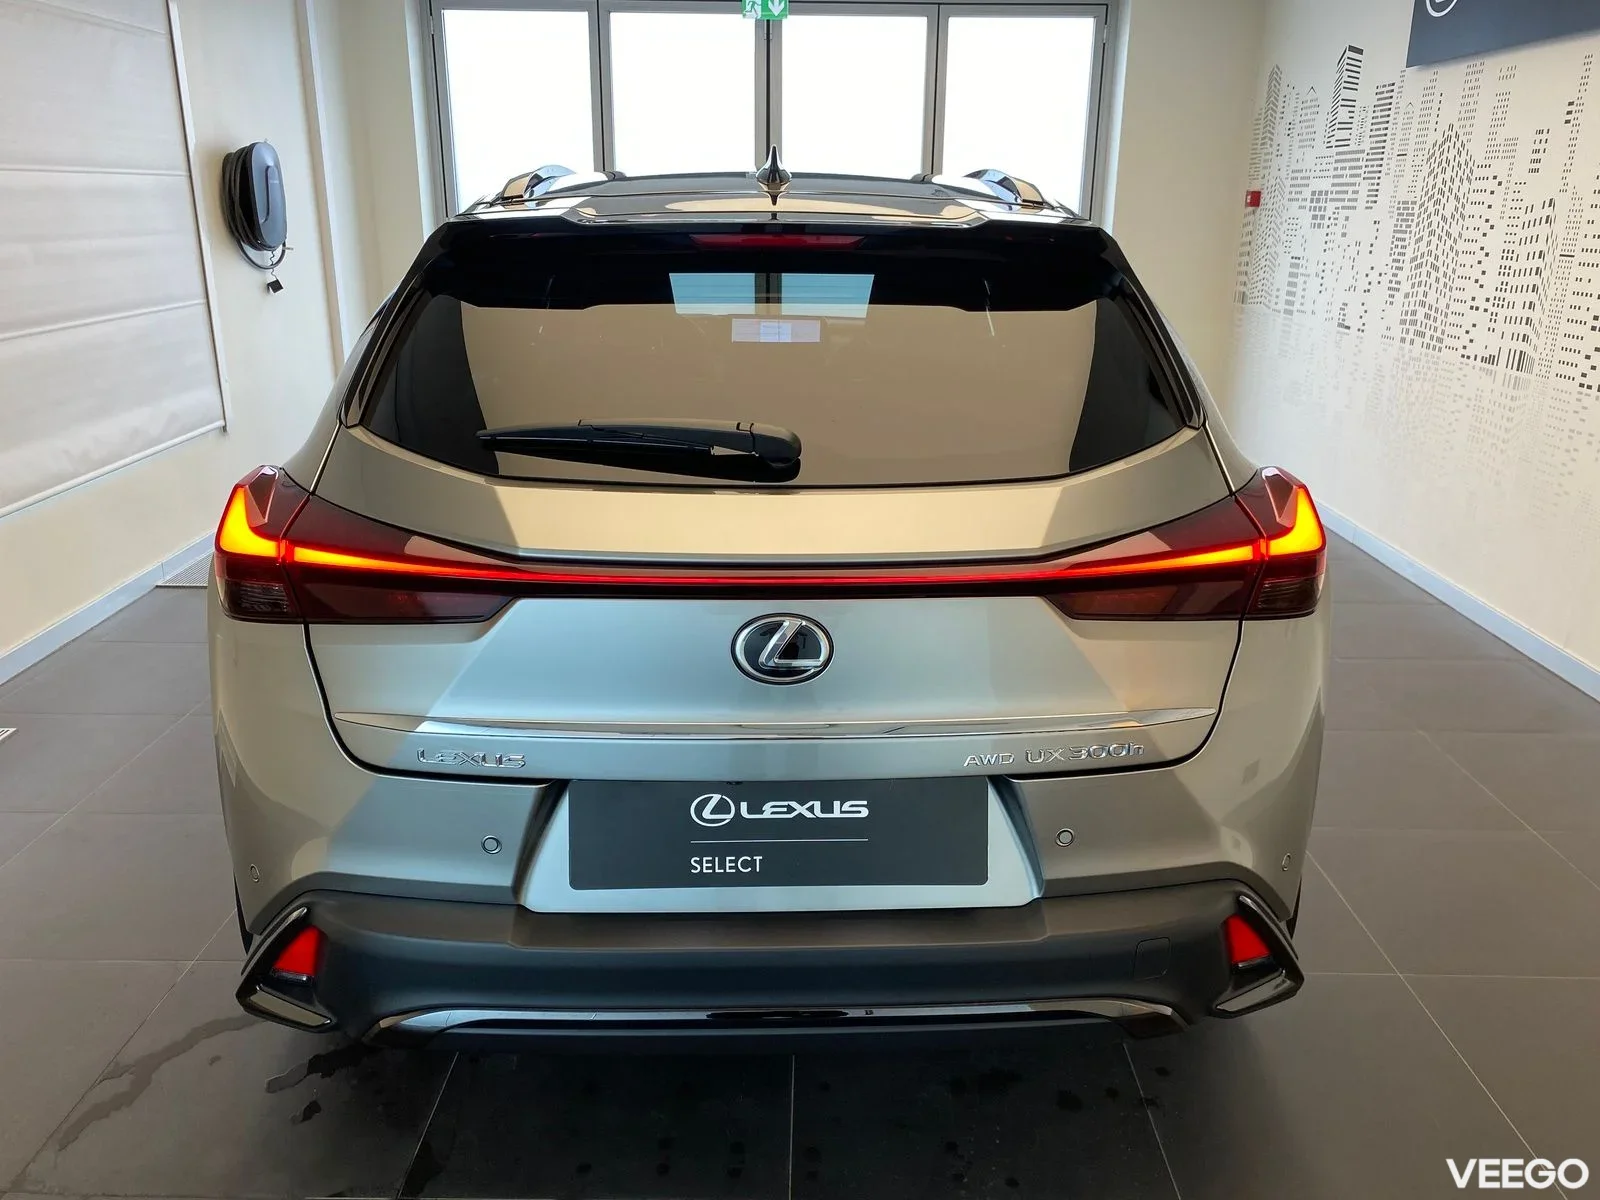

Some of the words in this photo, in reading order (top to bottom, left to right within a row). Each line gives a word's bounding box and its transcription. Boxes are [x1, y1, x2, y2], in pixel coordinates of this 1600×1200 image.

[417, 748, 526, 768] LEXUS
[963, 753, 1015, 767] AWD
[740, 801, 869, 818] LEXUS
[690, 856, 763, 873] SELECT
